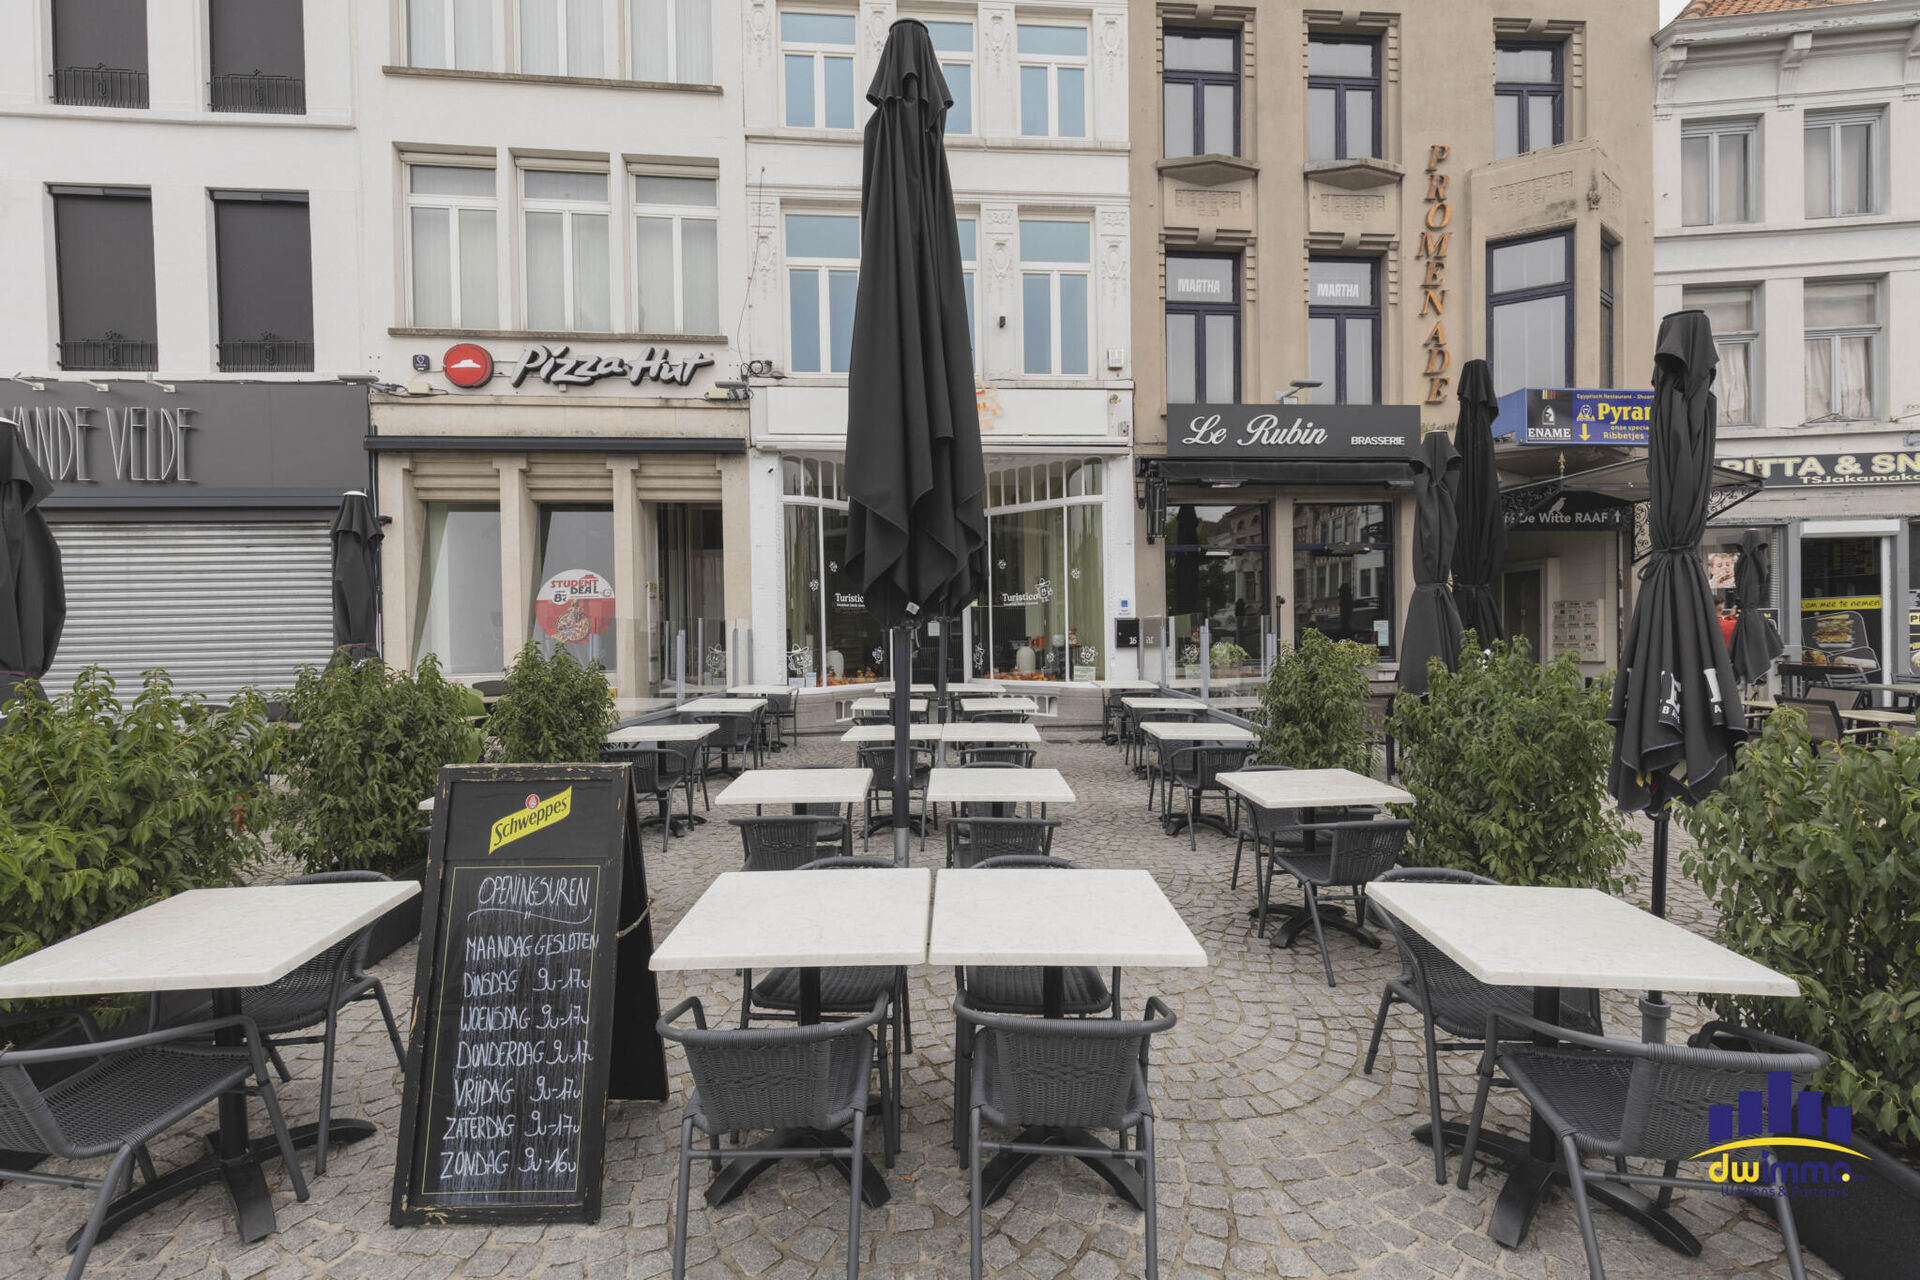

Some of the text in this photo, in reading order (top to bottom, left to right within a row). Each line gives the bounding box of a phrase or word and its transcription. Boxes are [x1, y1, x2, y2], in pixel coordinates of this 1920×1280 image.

[1177, 278, 1220, 293] MARTHA
[1416, 145, 1452, 405] PROMENADE
[1317, 283, 1359, 297] MARTHA
[511, 344, 715, 388] Pizza Hut
[1182, 414, 1328, 446] Le Rubin
[1351, 436, 1405, 446] BRASSERIE
[1528, 428, 1571, 437] ENAME
[1604, 432, 1644, 441] Ribbetjes
[106, 407, 192, 480] VELDE
[1834, 455, 1863, 475] &
[1871, 452, 1920, 473] SN
[1538, 512, 1572, 523] Witte
[1575, 512, 1609, 523] RAAF
[551, 579, 599, 589] STUDENT
[570, 586, 599, 594] DEAL
[834, 592, 865, 603] Turistic
[1002, 592, 1038, 602] Turistico
[494, 797, 567, 846] Schweppes
[466, 932, 599, 961] MAANDAG GESLOTEN
[461, 1006, 531, 1033] WOENSDAG
[457, 1041, 545, 1069] DONDERDAG
[443, 1114, 516, 1140] ZATERDAG
[440, 1150, 510, 1179] ZONDAG
